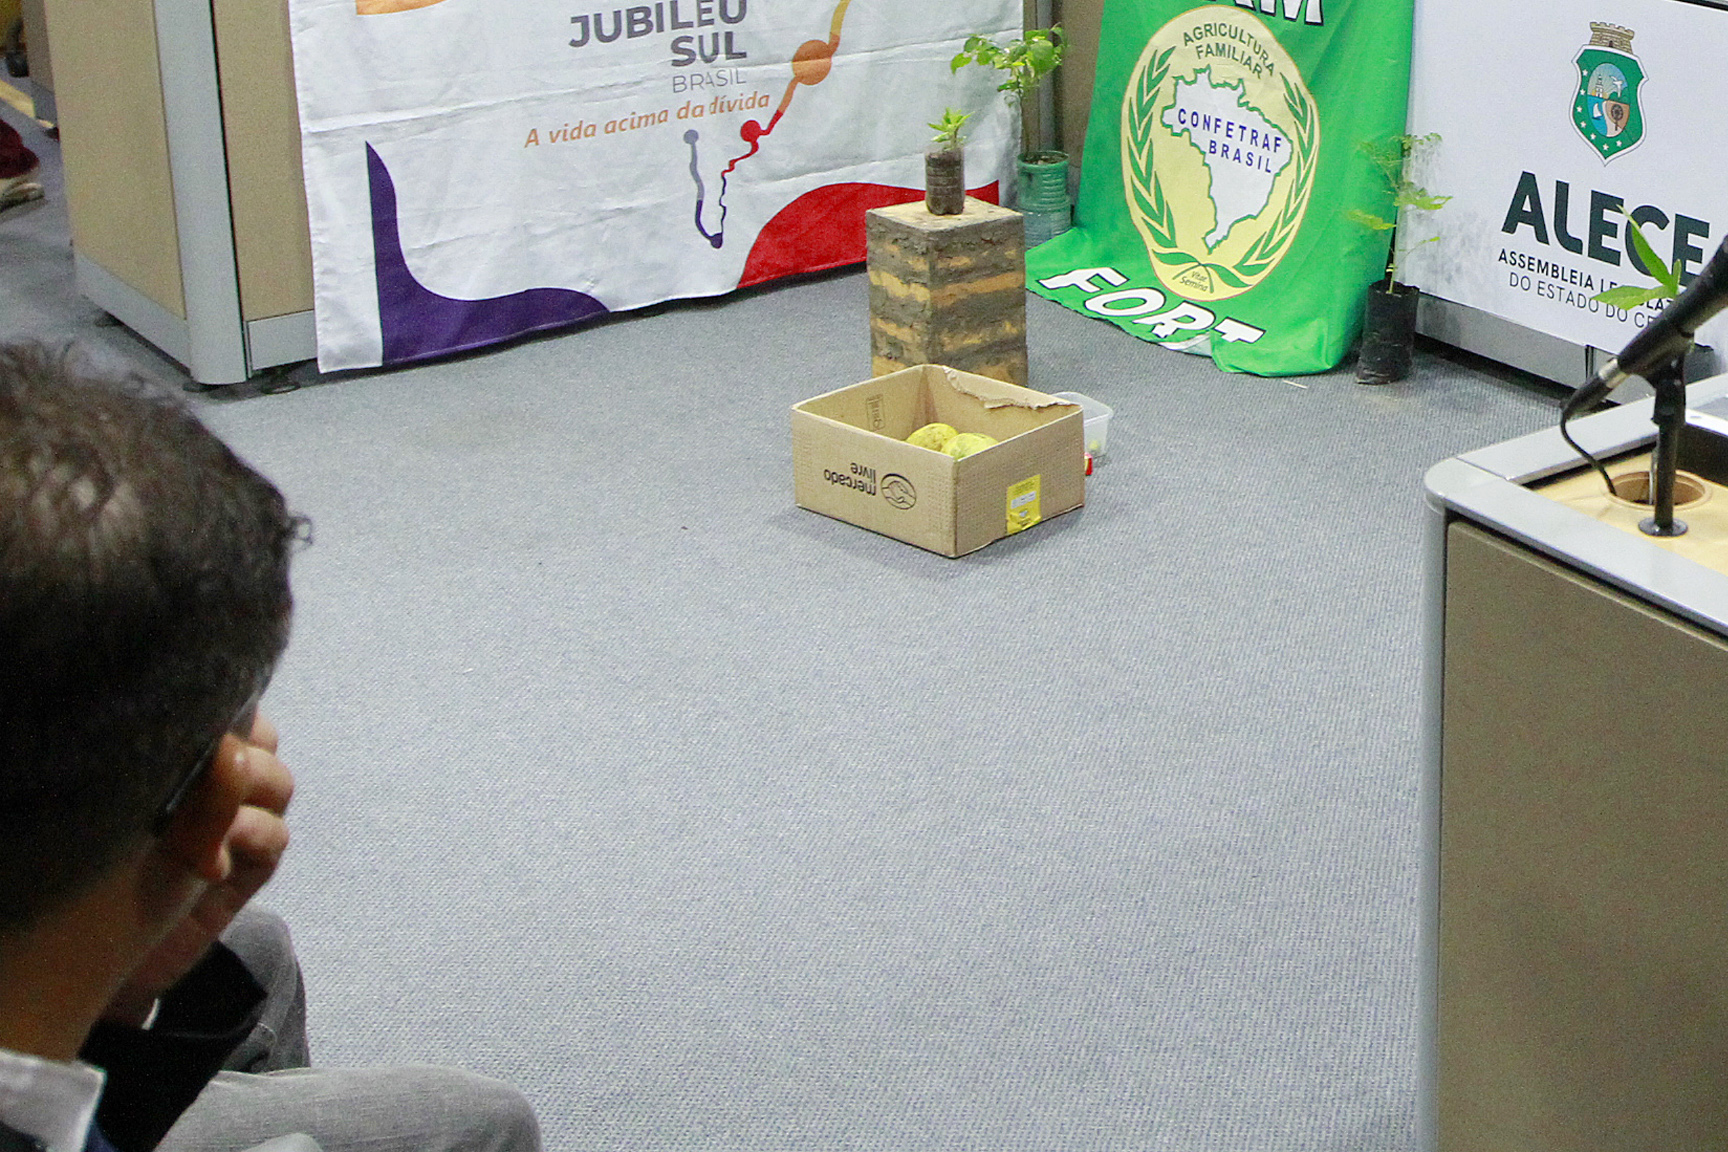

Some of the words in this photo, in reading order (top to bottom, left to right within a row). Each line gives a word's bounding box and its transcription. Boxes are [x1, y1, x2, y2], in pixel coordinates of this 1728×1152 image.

[671, 31, 747, 67] SUL
[1183, 22, 1276, 77] AGRICULTURA
[1196, 42, 1264, 80] FAMILIAR
[672, 68, 747, 94] BRASIL
[524, 128, 540, 148] A
[549, 119, 597, 144] vida
[604, 108, 669, 134] acima
[676, 100, 705, 121] da
[709, 91, 771, 115] dívida
[1178, 108, 1282, 153] CONFETRAF
[1209, 140, 1271, 174] BRASIL
[1501, 170, 1711, 289] ALECE
[1498, 248, 1595, 290] ASSEMBLEIA
[1036, 267, 1267, 344] FORT
[1509, 272, 1532, 292] DO
[1537, 282, 1600, 313] ESTADO
[1605, 302, 1628, 323] DO
[823, 469, 876, 496] mercado
[850, 462, 876, 484] livre
